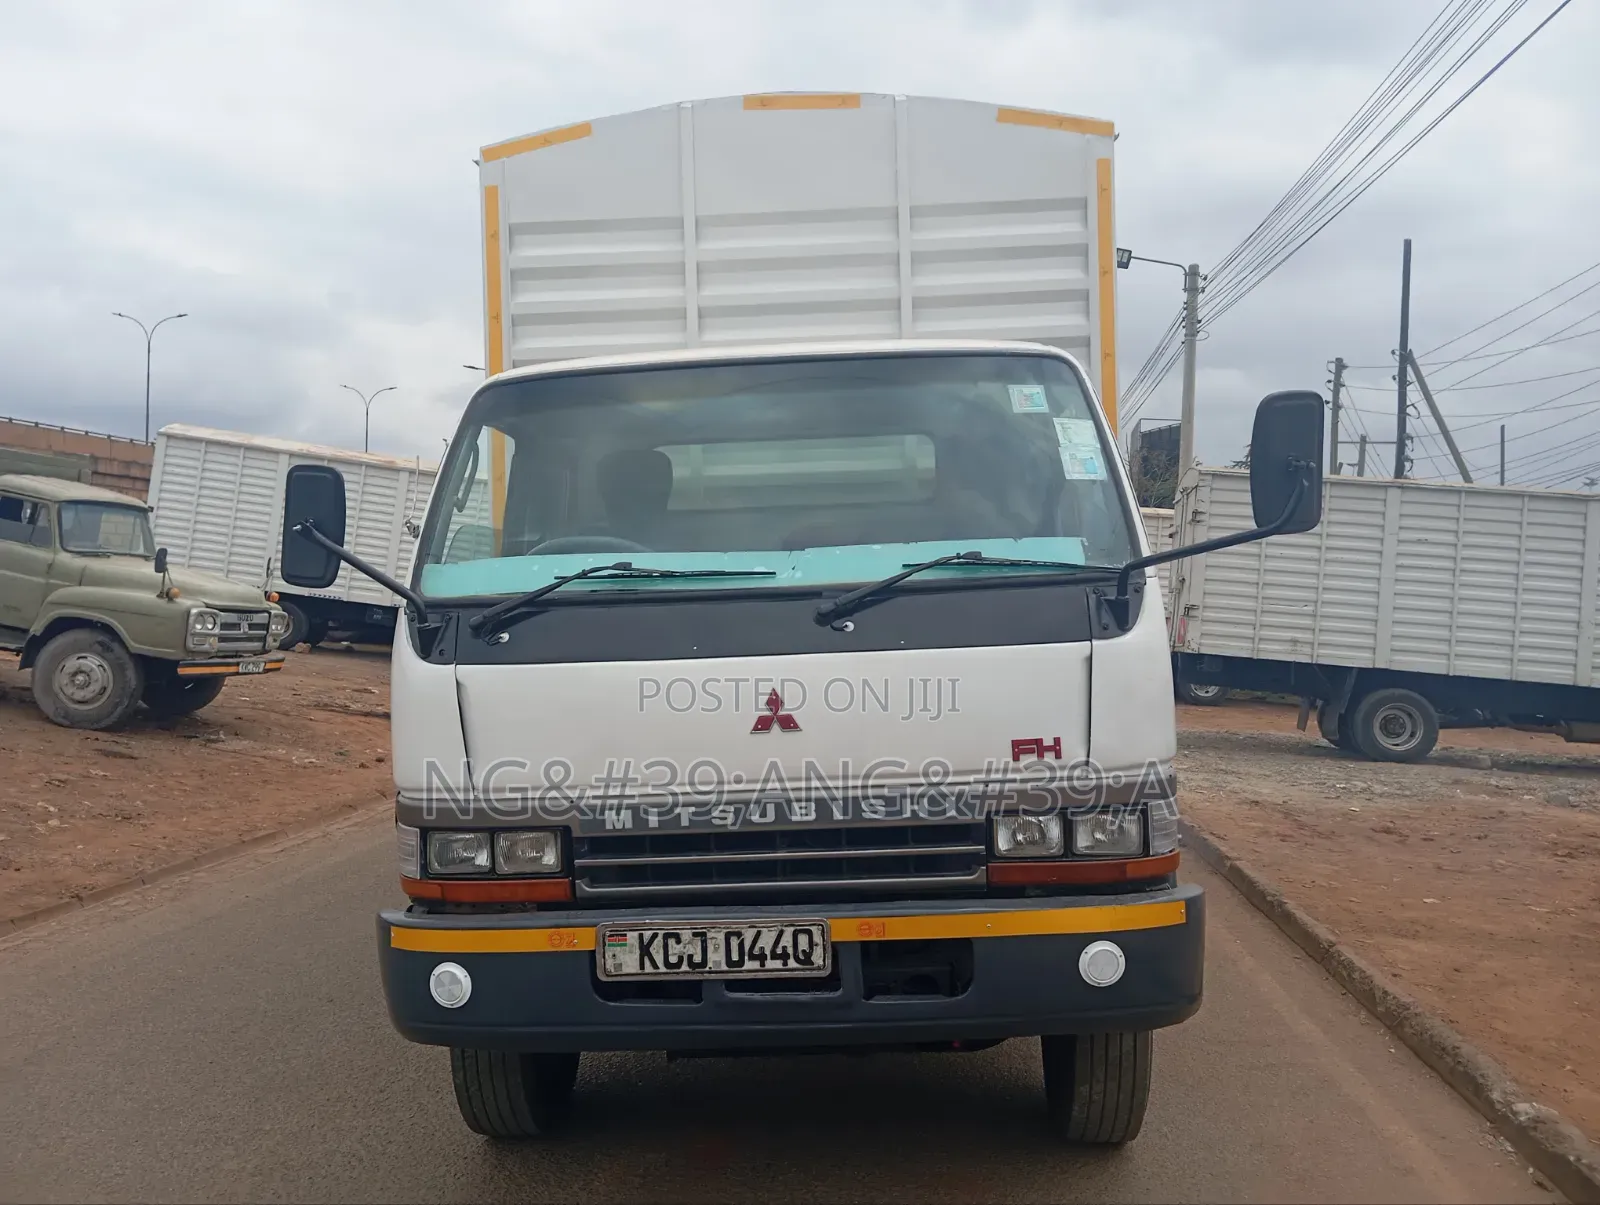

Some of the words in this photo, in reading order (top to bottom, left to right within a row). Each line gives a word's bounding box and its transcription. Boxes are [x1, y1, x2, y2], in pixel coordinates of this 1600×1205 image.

[1011, 736, 1063, 762] FH
[638, 931, 708, 970] KCJ
[724, 928, 815, 969] 044Q
